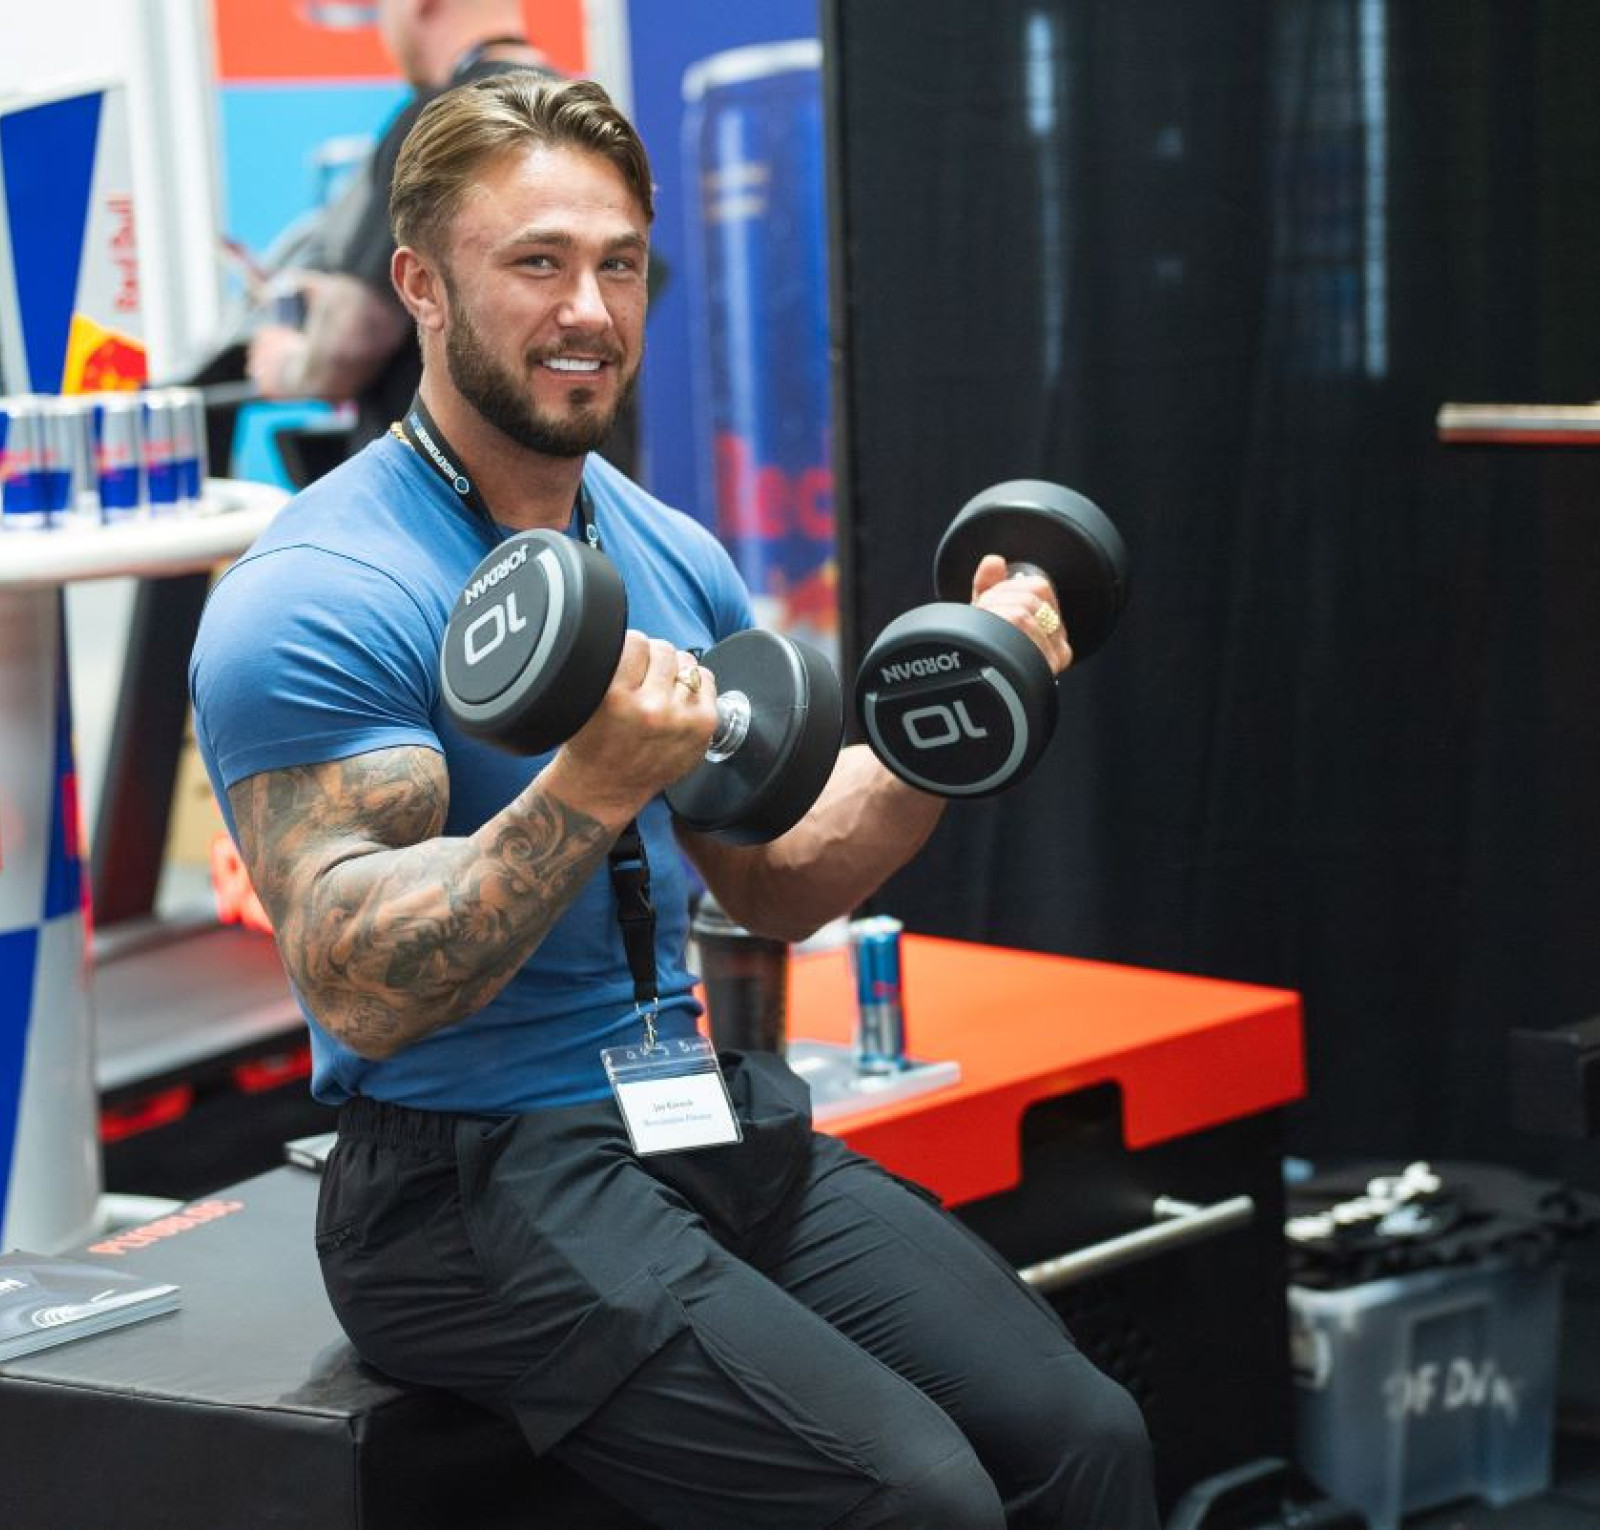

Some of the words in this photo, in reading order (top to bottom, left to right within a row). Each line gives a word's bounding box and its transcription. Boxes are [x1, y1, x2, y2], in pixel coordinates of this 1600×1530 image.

[465, 543, 529, 605] JORDAN
[464, 592, 527, 665] 10
[880, 651, 961, 684] JORDAN
[902, 700, 988, 749] 10
